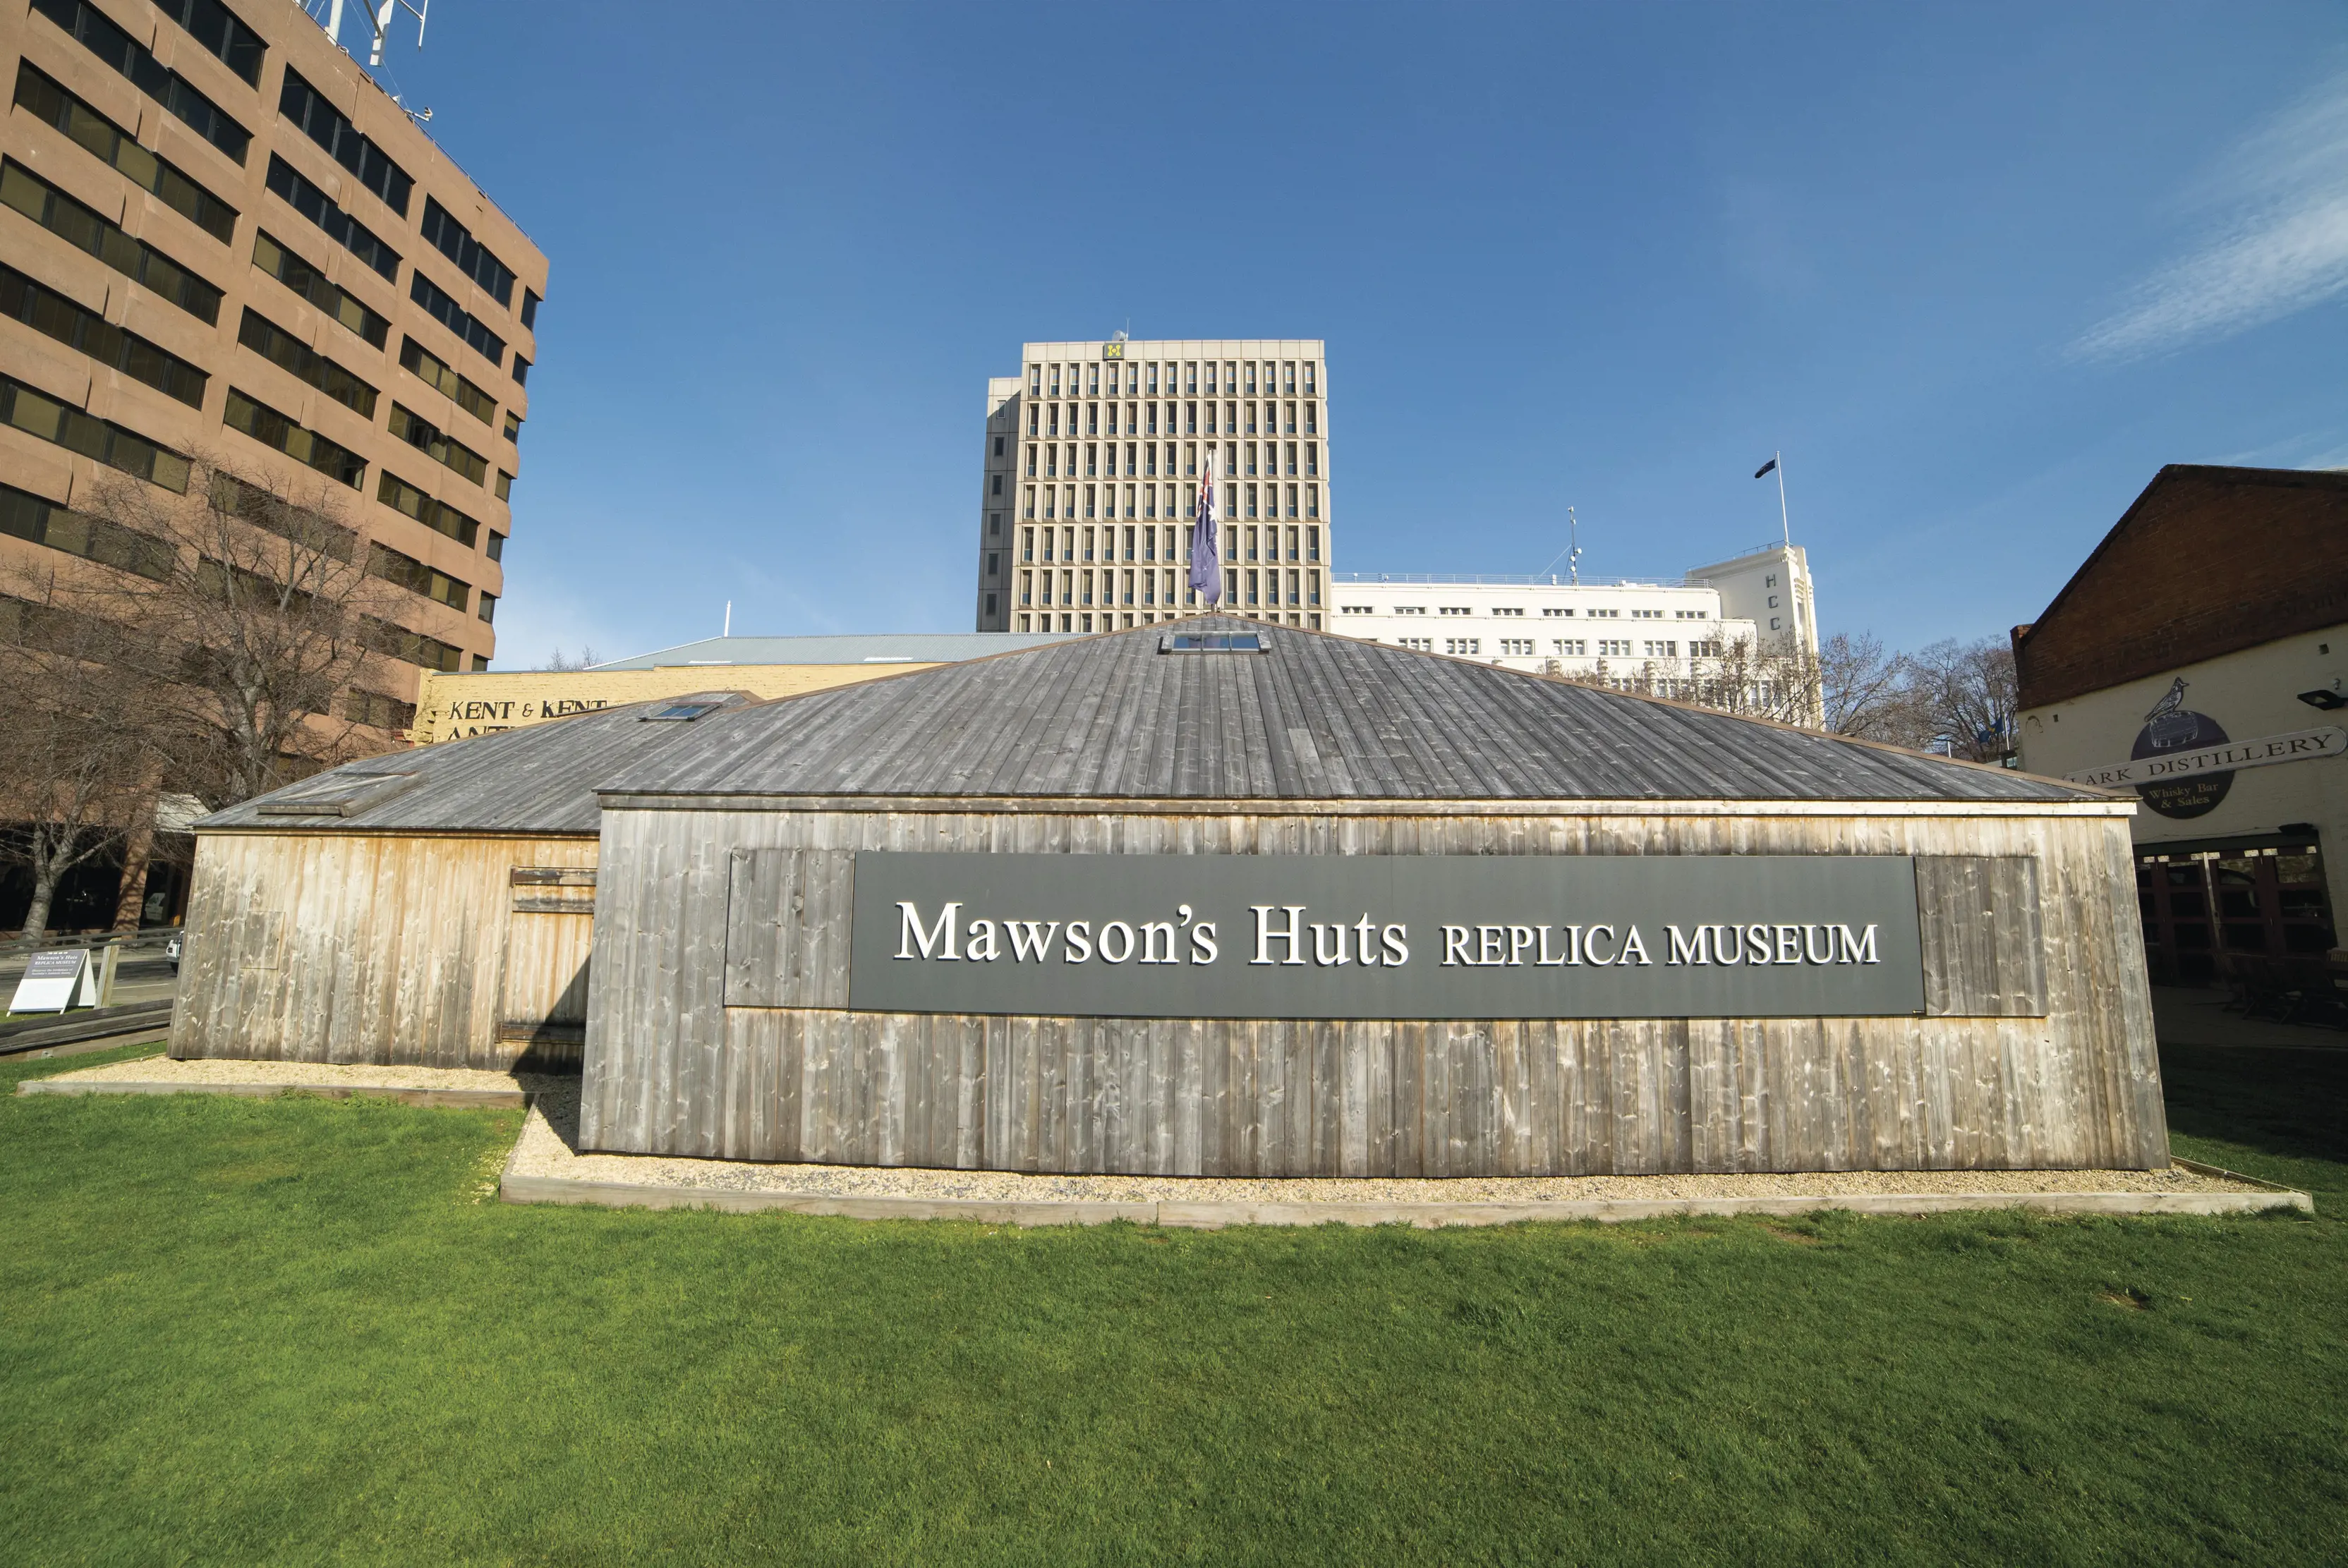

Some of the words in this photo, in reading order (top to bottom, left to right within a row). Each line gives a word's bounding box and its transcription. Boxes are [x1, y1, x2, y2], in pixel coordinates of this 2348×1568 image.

[448, 700, 515, 719] KENT
[521, 703, 534, 718] &
[2148, 734, 2333, 776] DISTILLERY
[2149, 786, 2191, 799] Whisky
[2197, 782, 2219, 793] Bar
[2161, 798, 2172, 808] &
[2177, 796, 2210, 807] Sales
[1250, 905, 1410, 966] Huts
[1440, 925, 1653, 966] REPLICA
[1664, 924, 1881, 964] MUSEUM
